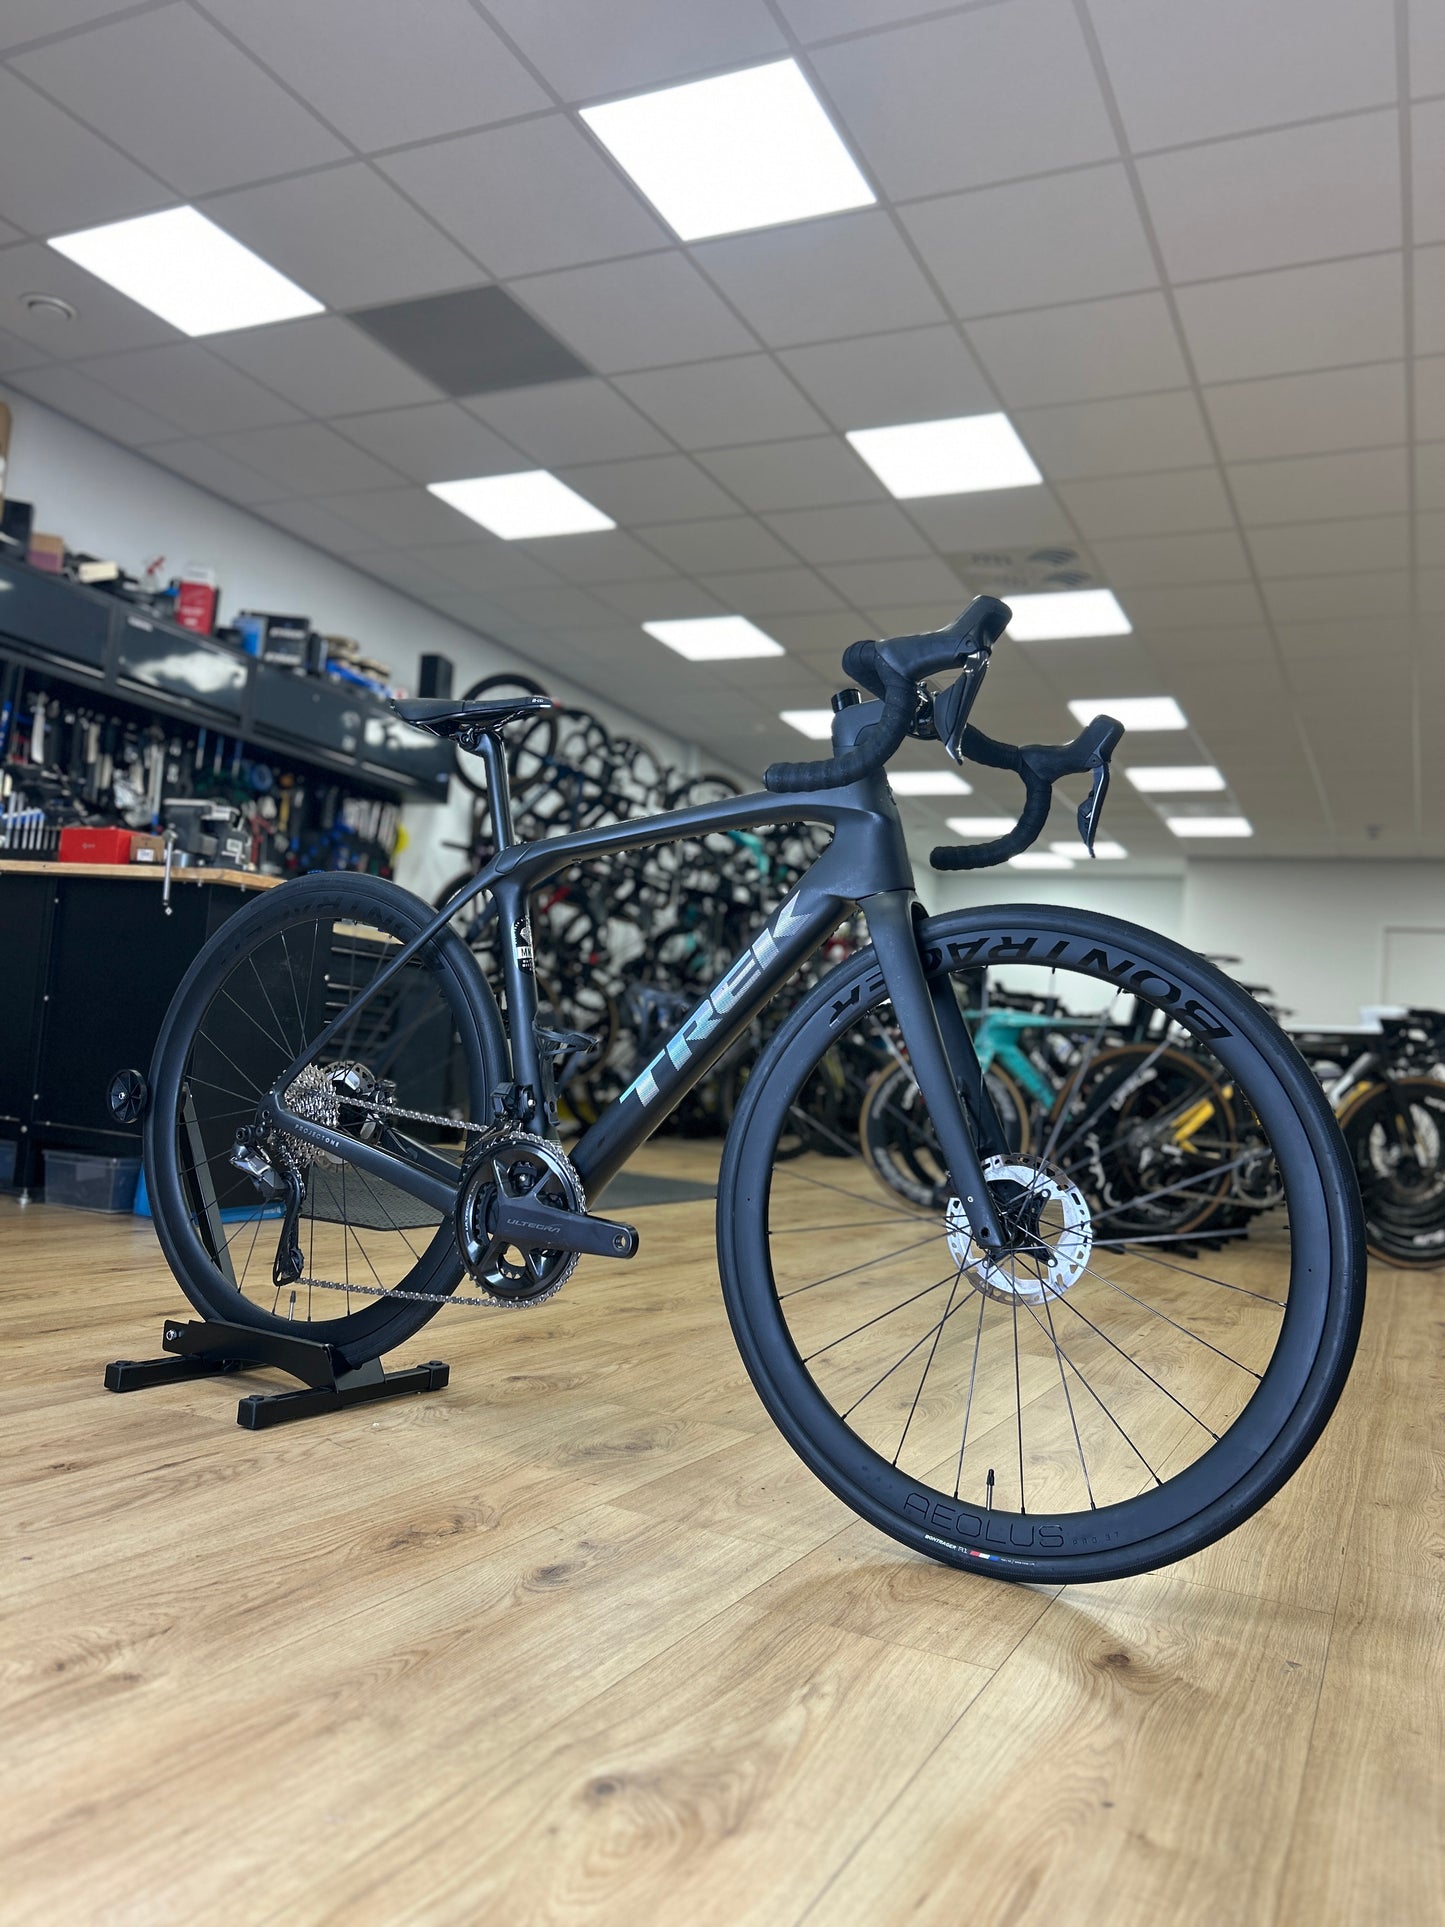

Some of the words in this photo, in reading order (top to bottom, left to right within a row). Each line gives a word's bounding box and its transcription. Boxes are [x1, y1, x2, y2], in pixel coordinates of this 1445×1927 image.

[619, 890, 812, 1107] TREK
[506, 1218, 561, 1233] ULTEGRA
[903, 1492, 1065, 1548] AEOLUS
[924, 1533, 957, 1550] BONTRAGER
